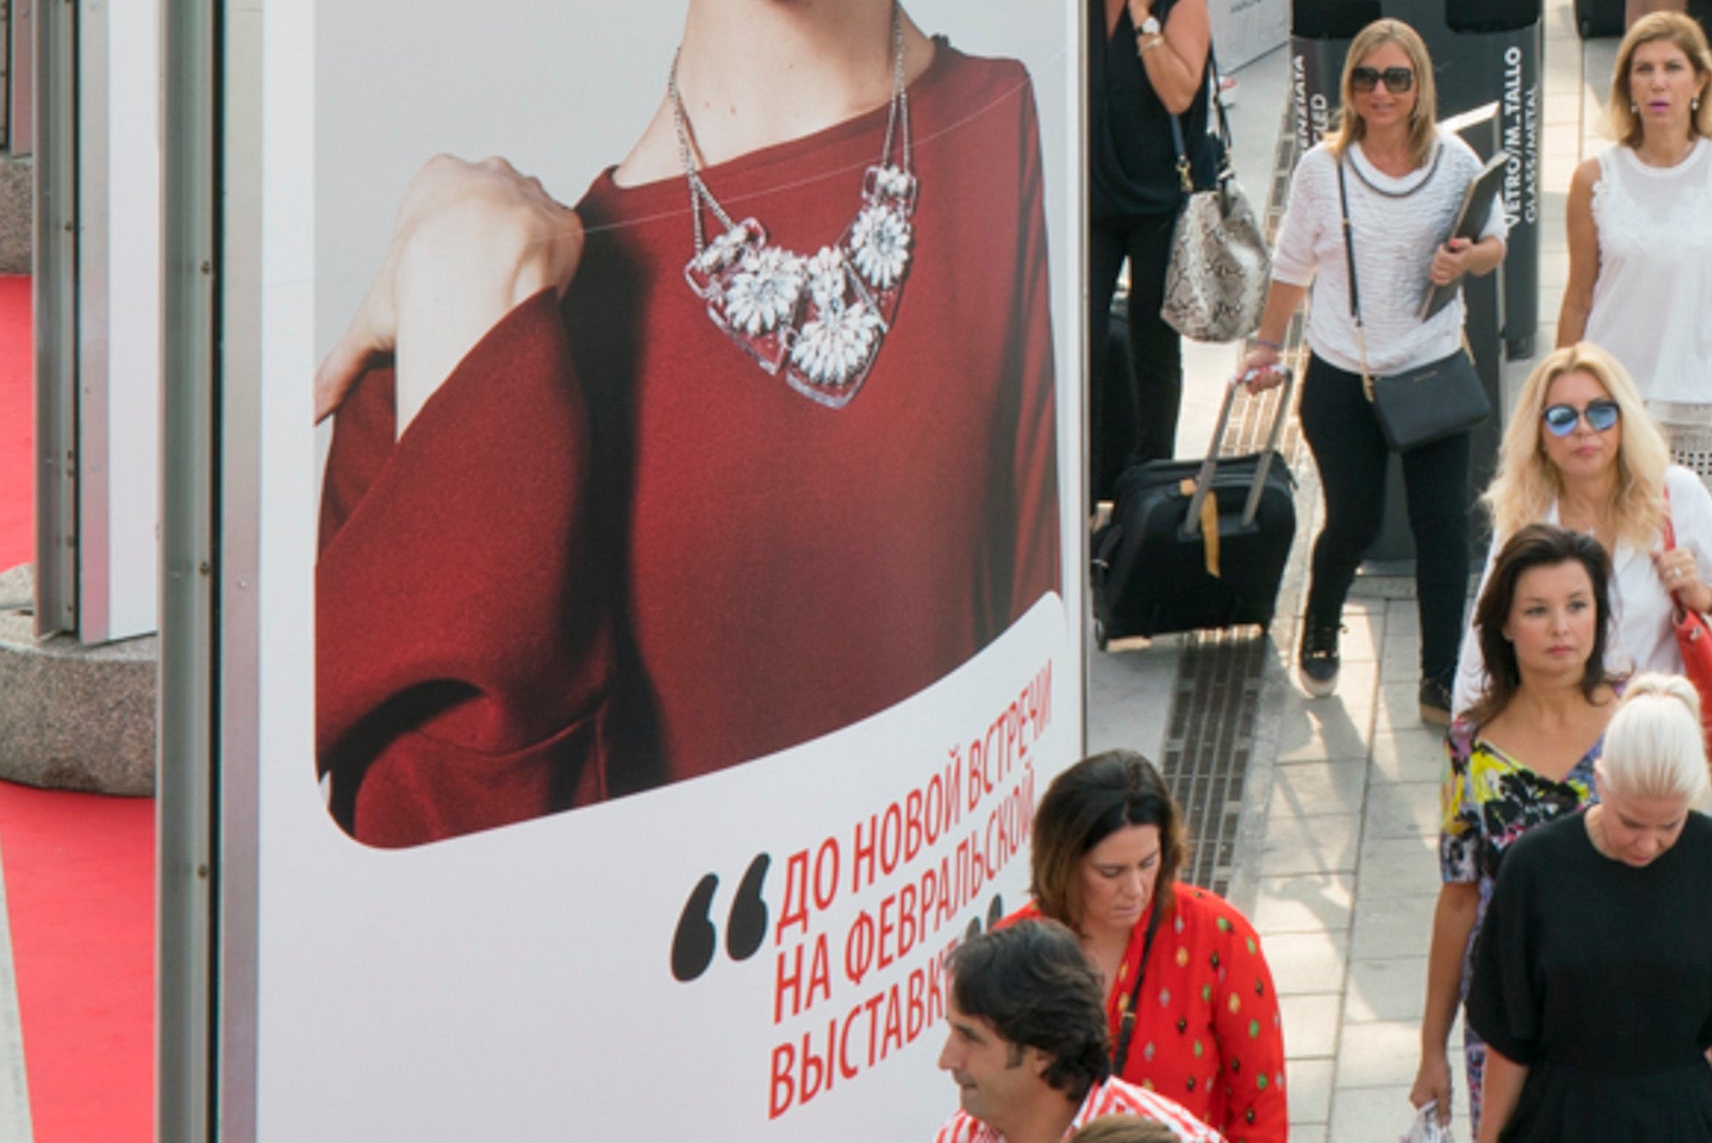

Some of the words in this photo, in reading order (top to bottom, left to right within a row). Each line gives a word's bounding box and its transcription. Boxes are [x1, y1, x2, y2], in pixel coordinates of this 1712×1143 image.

[1504, 46, 1522, 228] VETRO/MTALLO
[773, 933, 831, 1025] НА
[845, 757, 1034, 986] ФЕВРАЛЬСКОЙ
[775, 836, 840, 946] ДО
[851, 744, 962, 895] НОВОЙ
[968, 658, 1053, 813] ВСТРЕЧИ
